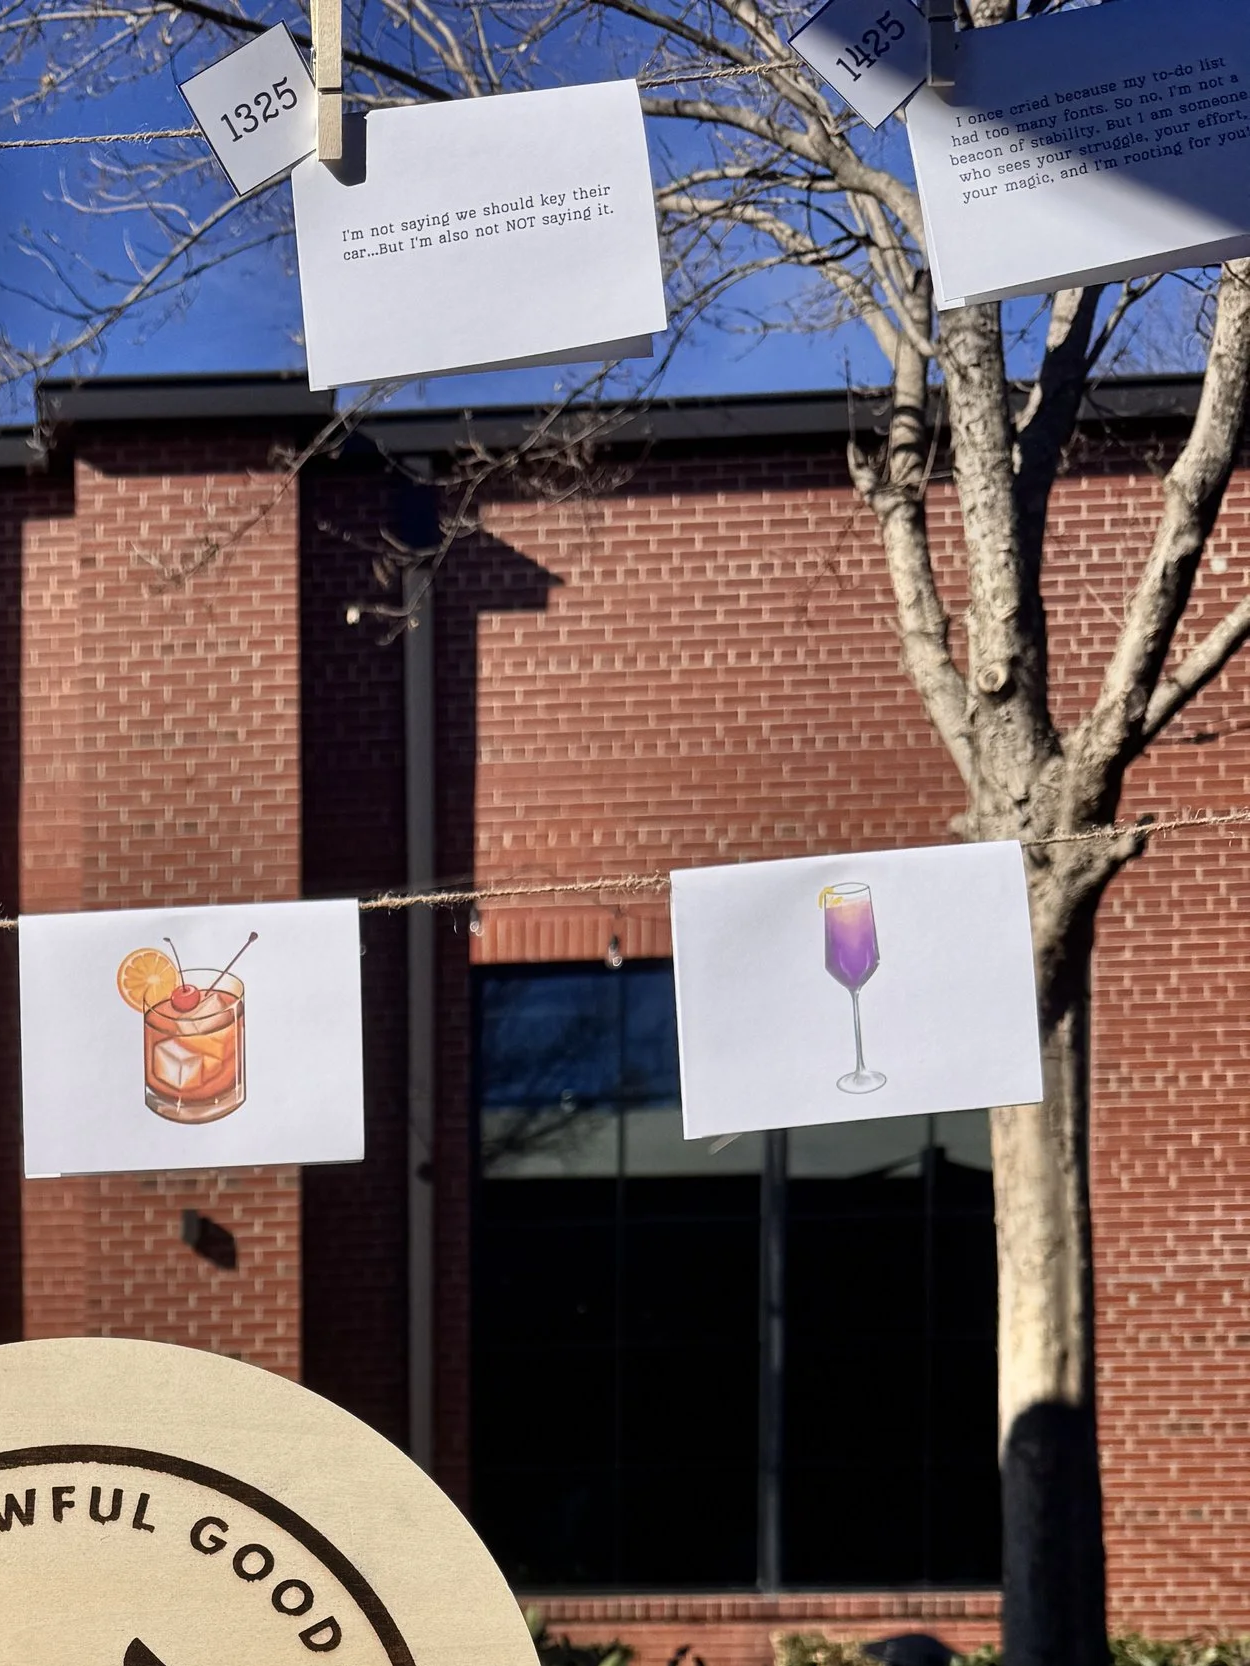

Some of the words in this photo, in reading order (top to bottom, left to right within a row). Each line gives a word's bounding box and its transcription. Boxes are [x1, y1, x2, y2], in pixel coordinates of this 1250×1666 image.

[835, 10, 905, 83] 1425
[220, 76, 298, 143] 1325
[949, 147, 1004, 166] beacon
[1009, 138, 1025, 154] of
[1030, 125, 1101, 149] stability.
[1105, 115, 1133, 131] But
[1149, 107, 1174, 121] am
[1178, 90, 1249, 115] someone
[950, 130, 980, 148] had
[985, 126, 1010, 140] too
[1014, 114, 1058, 134] many
[1063, 104, 1109, 123] fonts.
[1113, 97, 1133, 110] So
[1167, 84, 1193, 98] I'm
[1196, 76, 1225, 92] not
[1229, 74, 1239, 84] a
[955, 116, 962, 128] I
[967, 109, 1003, 125] once
[1009, 94, 1052, 116] cried
[1054, 82, 1118, 105] because
[1122, 75, 1146, 89] my
[1152, 64, 1194, 83] to-do
[1199, 57, 1227, 72] list
[958, 168, 992, 183] who
[997, 159, 1031, 175] sees
[1035, 149, 1072, 169] your
[1078, 131, 1149, 157] struggle,
[1153, 122, 1191, 143] your
[1197, 109, 1250, 129] effort,
[962, 185, 998, 205] your
[1003, 172, 1055, 192] magic,
[1060, 162, 1089, 180] and
[1094, 157, 1119, 172] I'm
[1122, 140, 1183, 166] rooting
[1187, 136, 1212, 150] for
[342, 229, 365, 242] I'm
[370, 223, 395, 237] not
[400, 211, 450, 232] saying
[455, 209, 477, 221] we
[482, 195, 535, 217] should
[539, 193, 566, 207] key
[572, 184, 611, 201] their
[410, 236, 433, 249] I'm
[438, 229, 469, 244] also
[474, 223, 500, 238] not
[505, 215, 536, 232] NOT
[541, 206, 592, 226] saying
[597, 202, 614, 216] it.
[189, 1515, 343, 1654] GOOD
